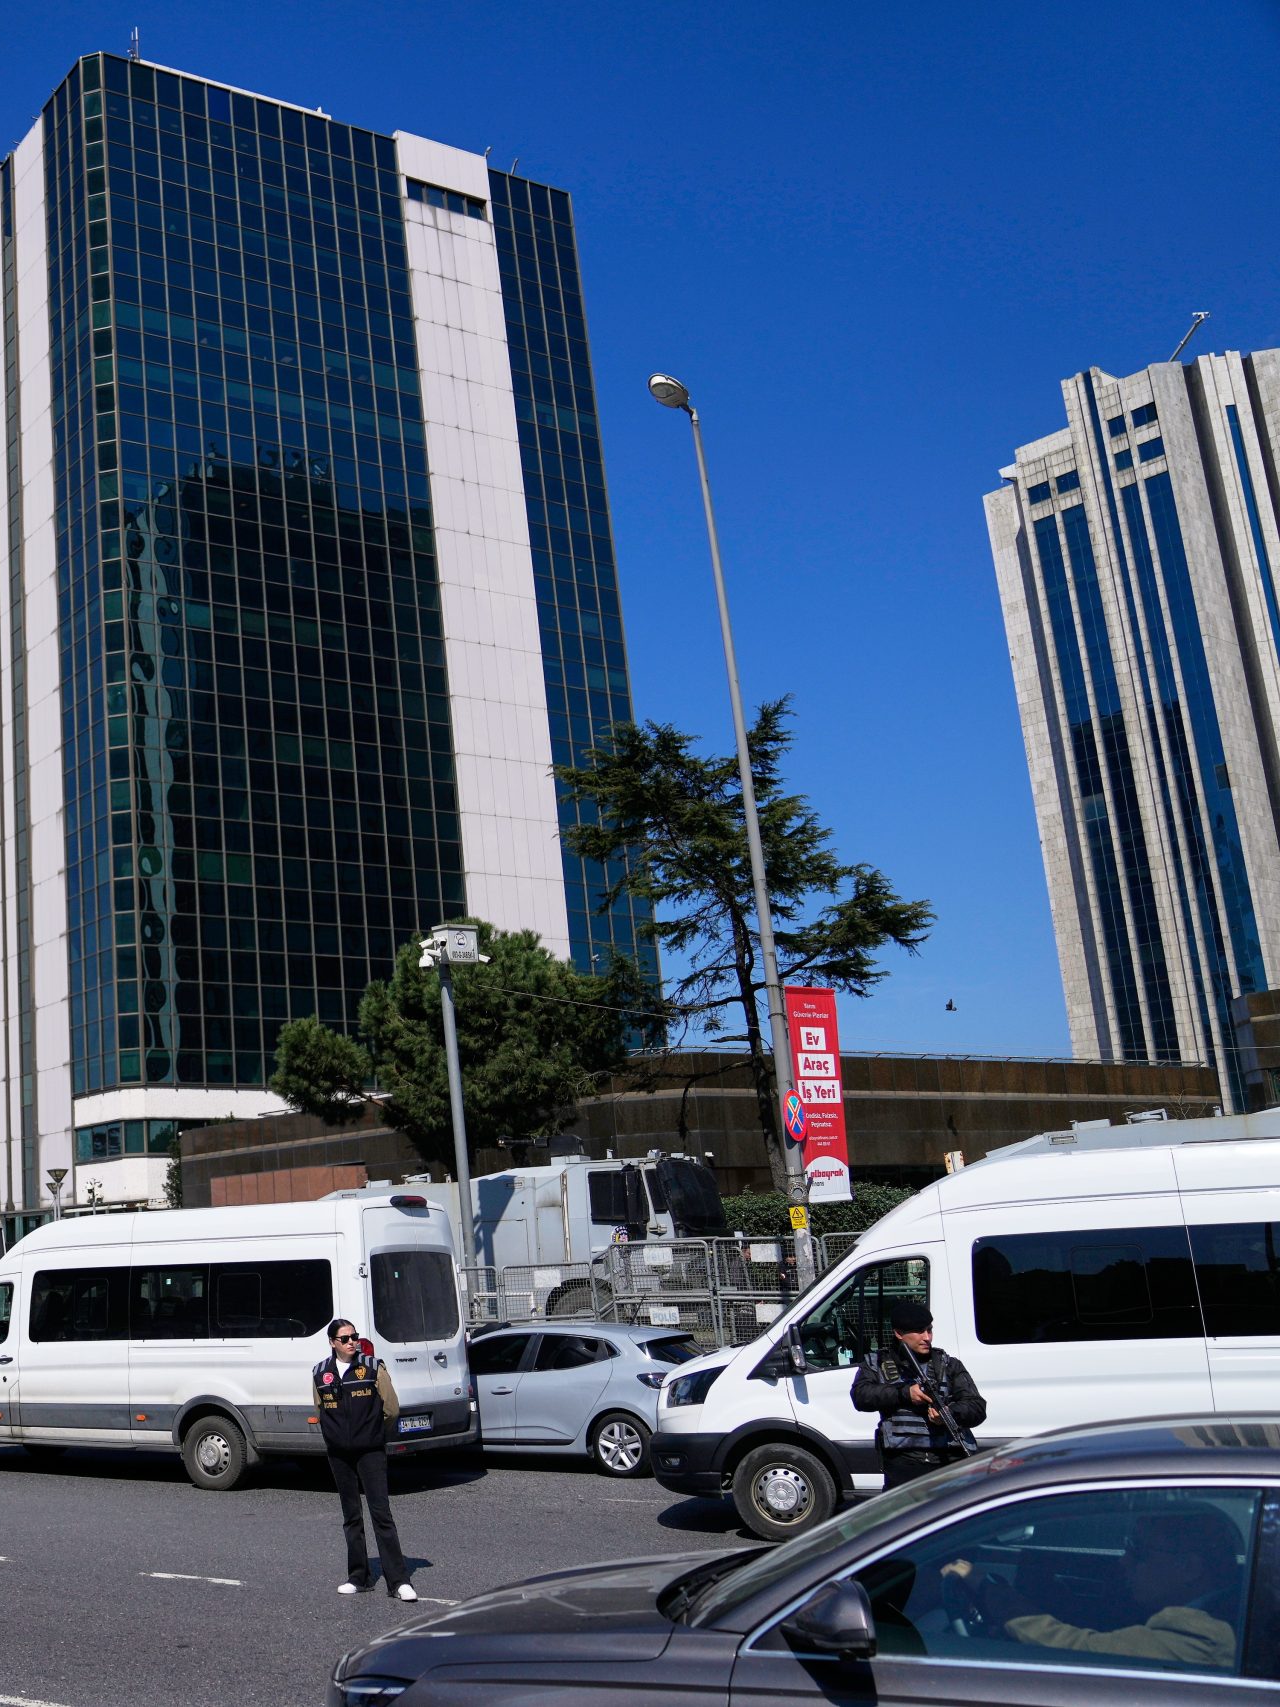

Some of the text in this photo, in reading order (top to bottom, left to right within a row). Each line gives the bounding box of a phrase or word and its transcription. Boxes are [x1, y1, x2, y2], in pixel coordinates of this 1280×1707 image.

[806, 1032, 820, 1045] Ev
[803, 1057, 830, 1074] Araç
[802, 1082, 836, 1102] İş Yeri
[811, 1169, 843, 1180] albayrak
